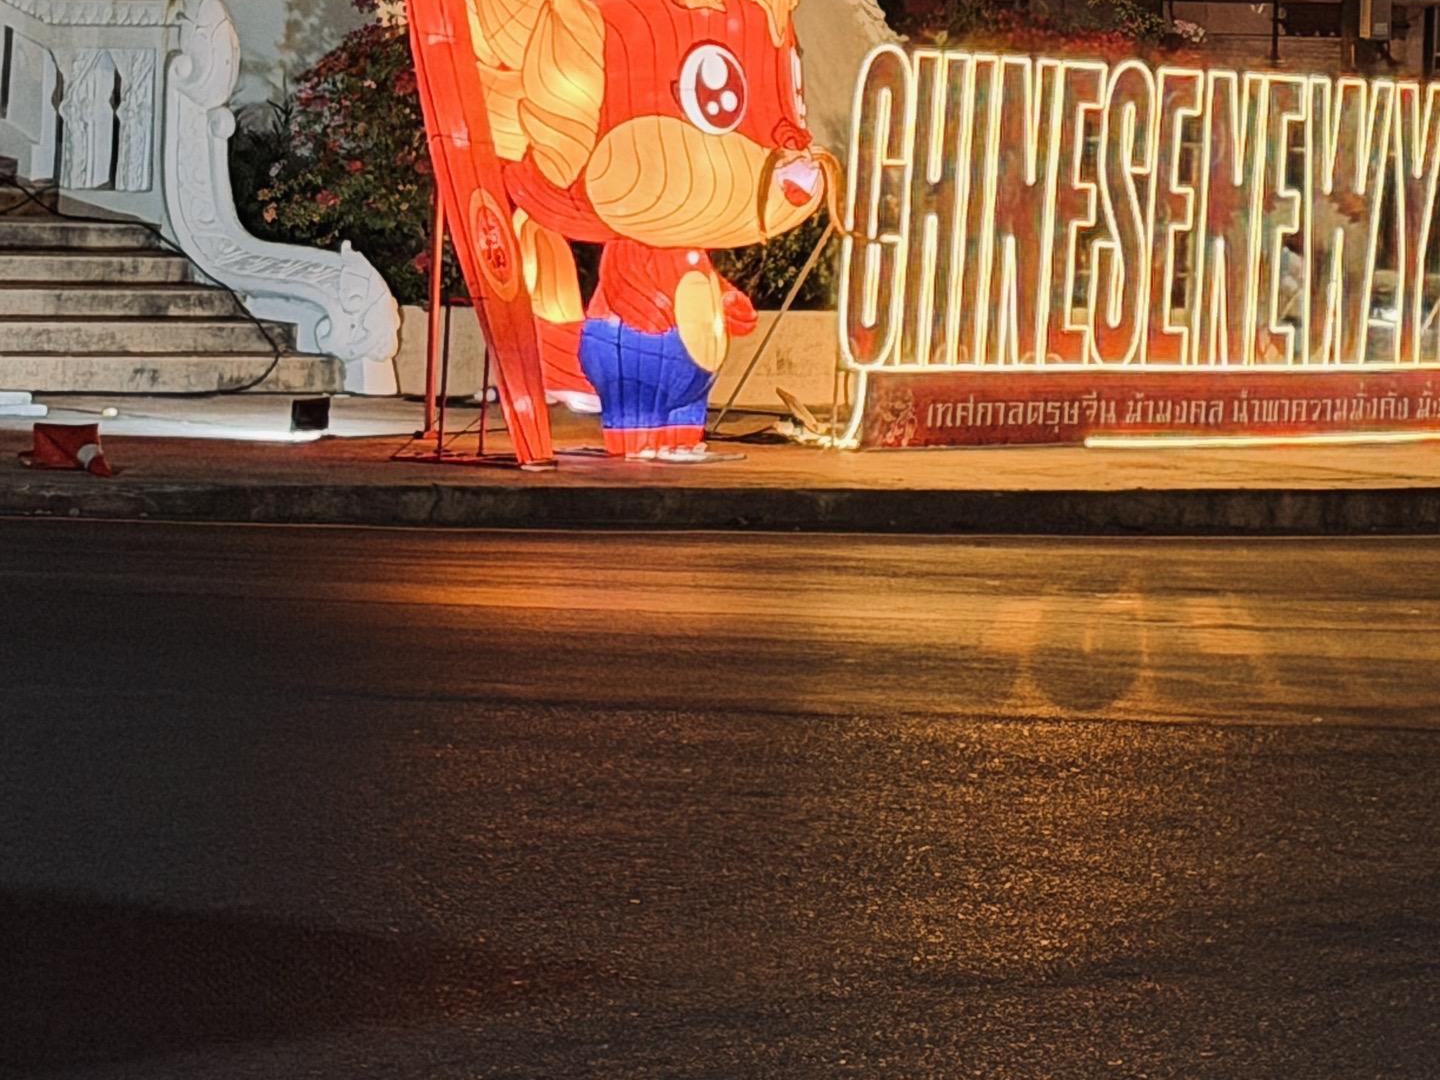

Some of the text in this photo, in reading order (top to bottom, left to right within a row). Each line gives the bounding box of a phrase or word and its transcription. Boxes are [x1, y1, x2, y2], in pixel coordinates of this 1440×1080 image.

[926, 391, 1117, 432] เทศกาลตรุษจีน
